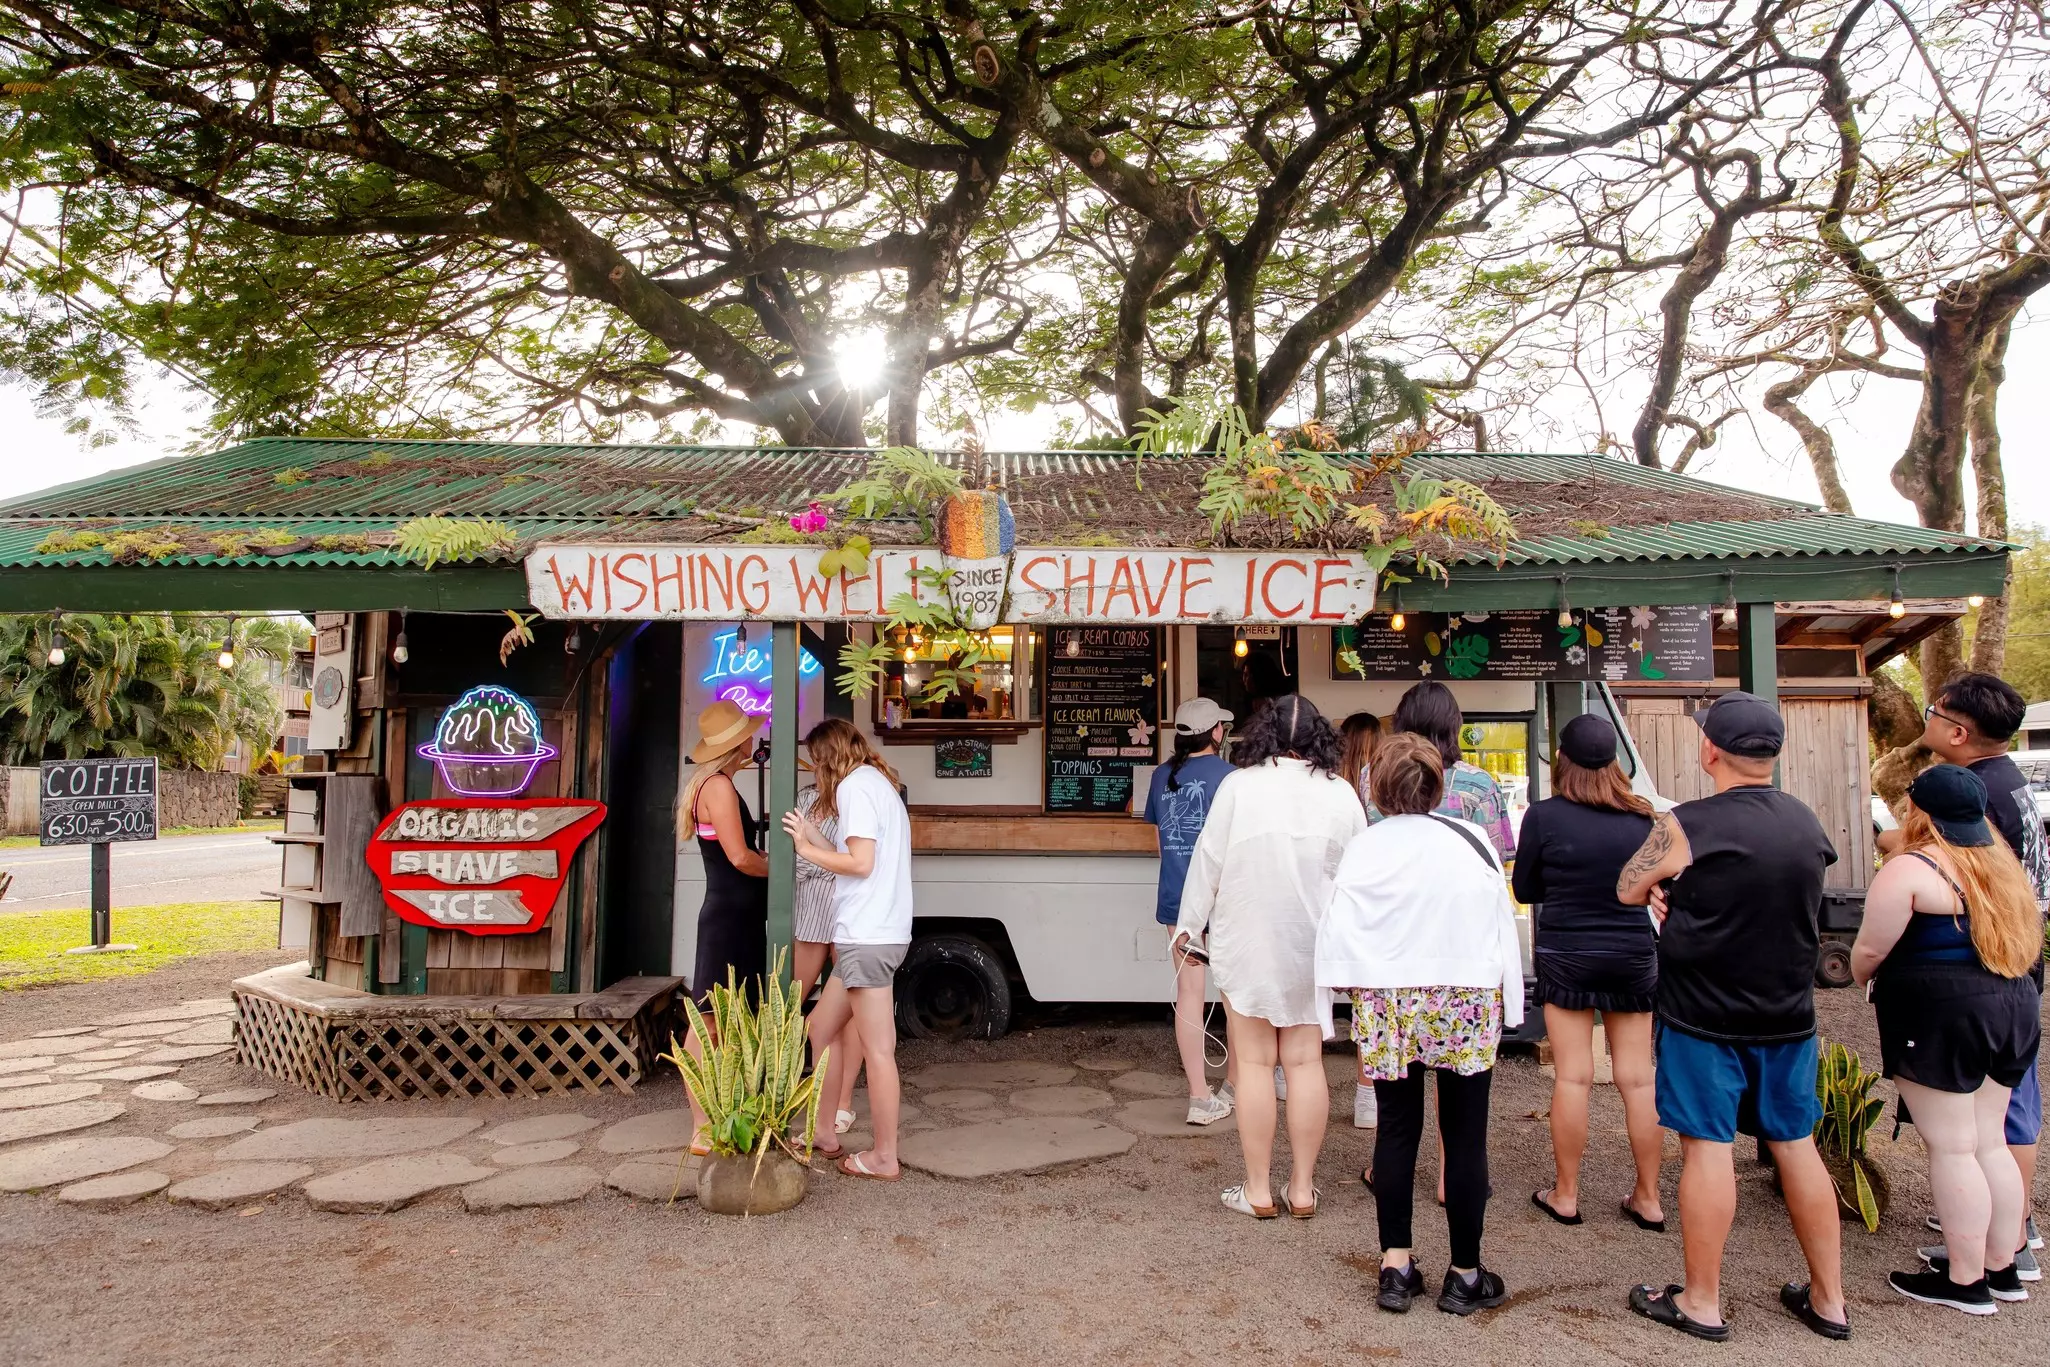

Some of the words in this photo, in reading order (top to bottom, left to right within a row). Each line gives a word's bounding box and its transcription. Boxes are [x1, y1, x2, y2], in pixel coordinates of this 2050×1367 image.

[547, 552, 770, 615] WISHING
[952, 568, 1002, 587] SINCE
[1020, 556, 1215, 619] SHAVE
[1242, 558, 1353, 620] ICE
[955, 591, 997, 613] 1983
[1113, 630, 1150, 647] COMBOS
[1245, 626, 1269, 635] HERE
[703, 631, 763, 682] Ice
[1053, 709, 1068, 722] ICE
[1070, 708, 1100, 722] CREAM
[1104, 708, 1142, 724] FLAVORS
[936, 741, 954, 752] SKIP
[936, 769, 954, 777] SAVE
[965, 768, 992, 776] TURTLE
[1052, 760, 1102, 775] TOPPINGS
[46, 763, 154, 797] COFFEE
[1178, 787, 1184, 795] IT
[74, 800, 94, 810] OPEN
[97, 800, 118, 810] DAILY
[49, 814, 88, 838] 6:30
[87, 826, 100, 834] AM
[105, 811, 145, 836] 5:00
[144, 823, 154, 833] PM
[398, 809, 540, 839] ORGANIC
[398, 851, 519, 881] SHAVE
[428, 893, 495, 920] ICE
